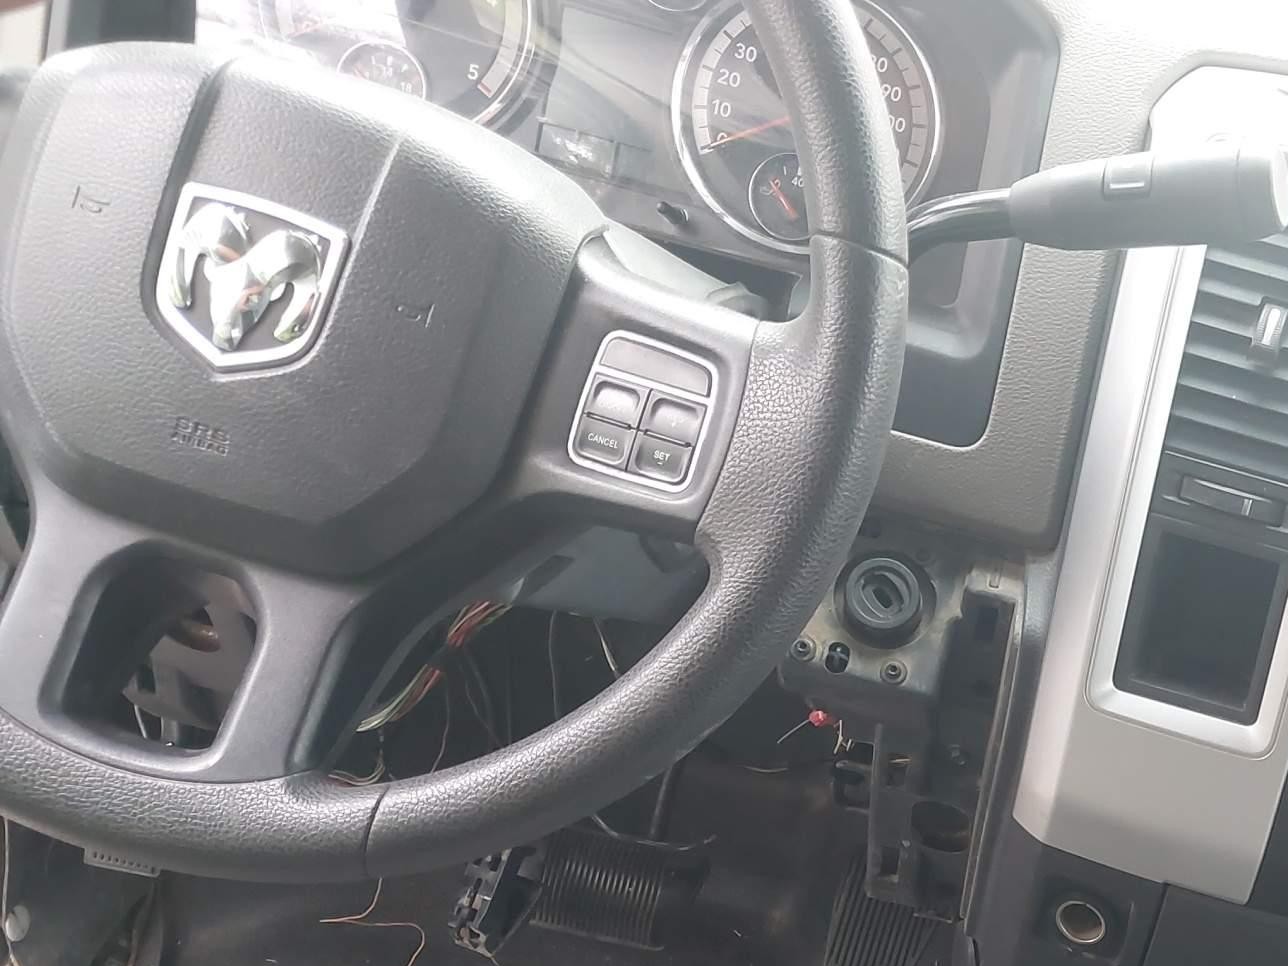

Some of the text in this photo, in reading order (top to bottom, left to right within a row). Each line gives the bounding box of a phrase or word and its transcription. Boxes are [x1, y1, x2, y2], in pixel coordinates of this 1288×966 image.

[734, 42, 758, 63] 30
[467, 63, 480, 80] 5
[717, 68, 741, 88] 20
[711, 98, 732, 118] 10
[587, 432, 619, 450] CANCEL
[653, 449, 671, 462] SET
